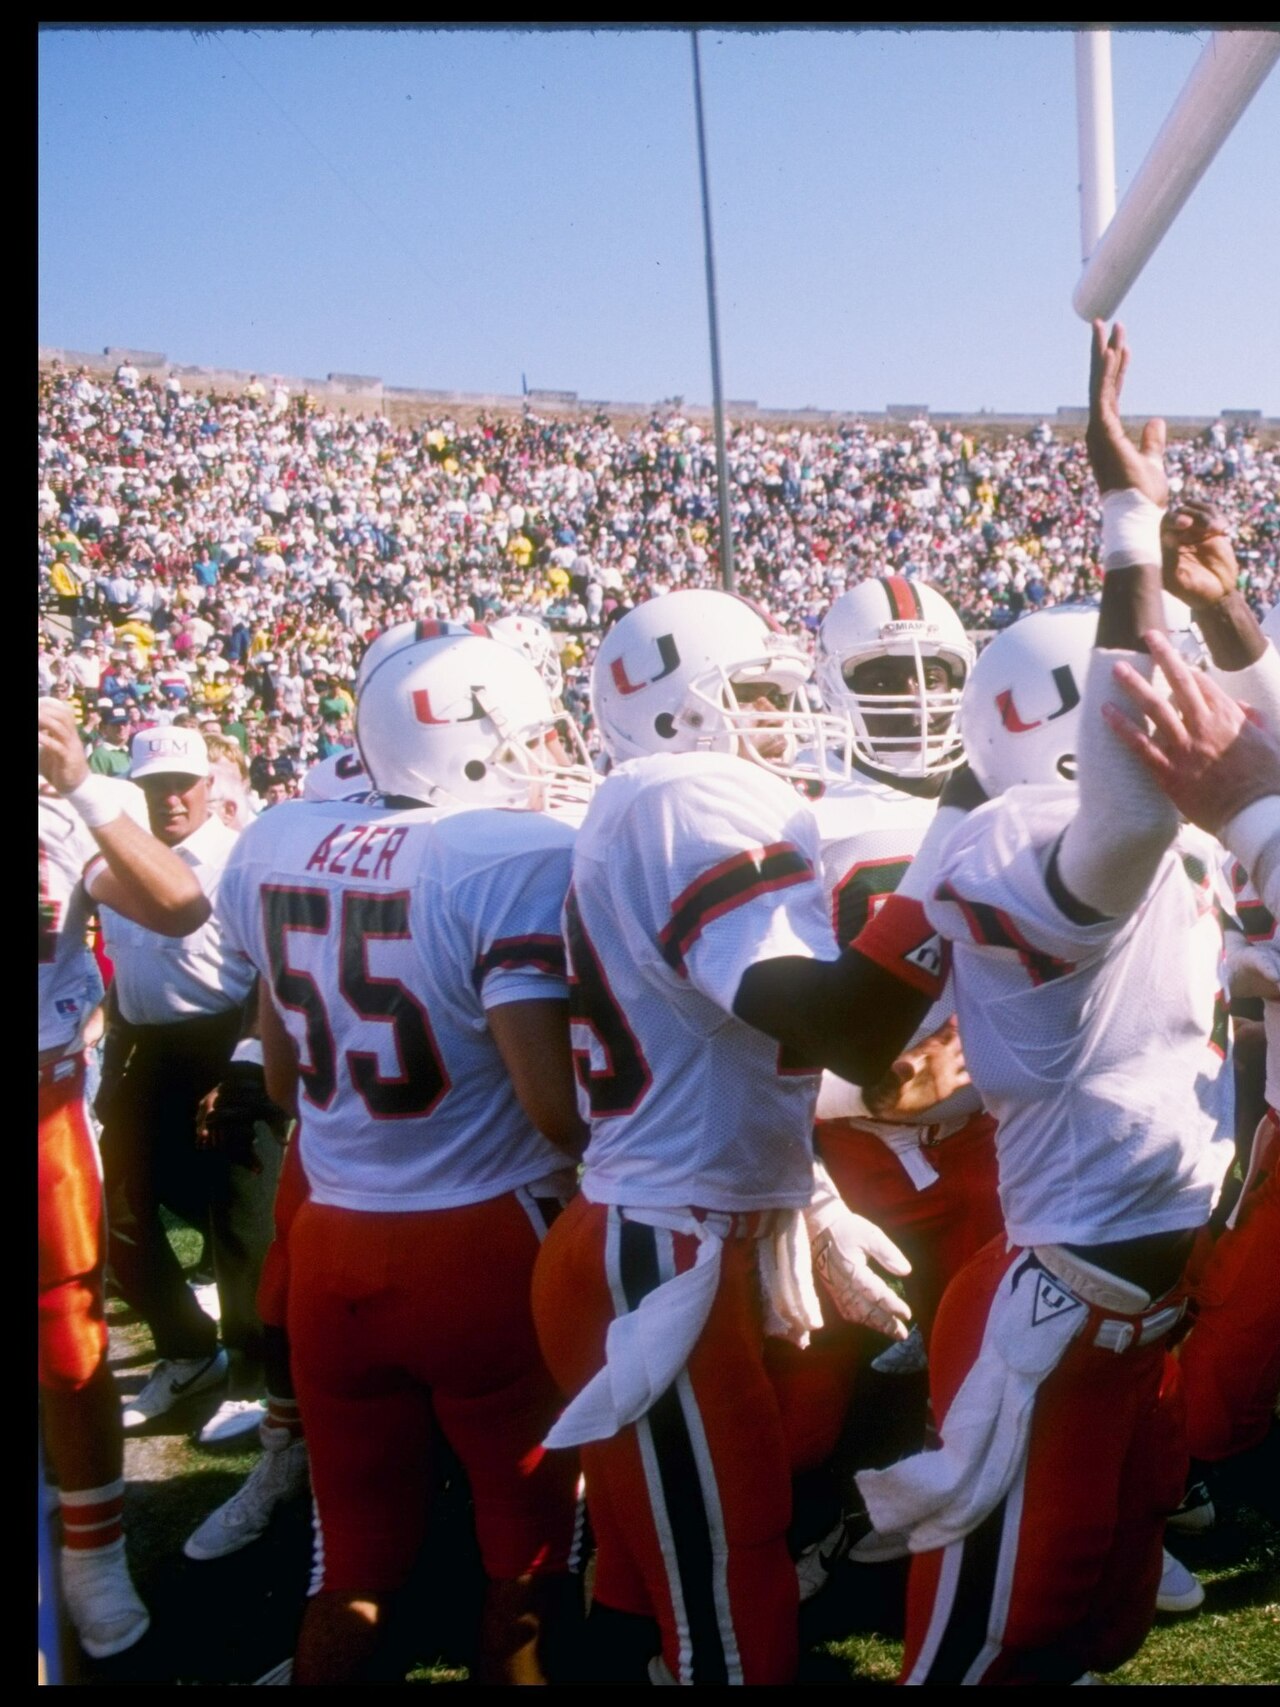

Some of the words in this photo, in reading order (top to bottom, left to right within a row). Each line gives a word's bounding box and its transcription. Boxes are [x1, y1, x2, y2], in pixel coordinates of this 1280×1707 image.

[609, 633, 681, 696] U
[995, 664, 1081, 734] U
[305, 824, 409, 880] AZER
[260, 883, 453, 1121] 55
